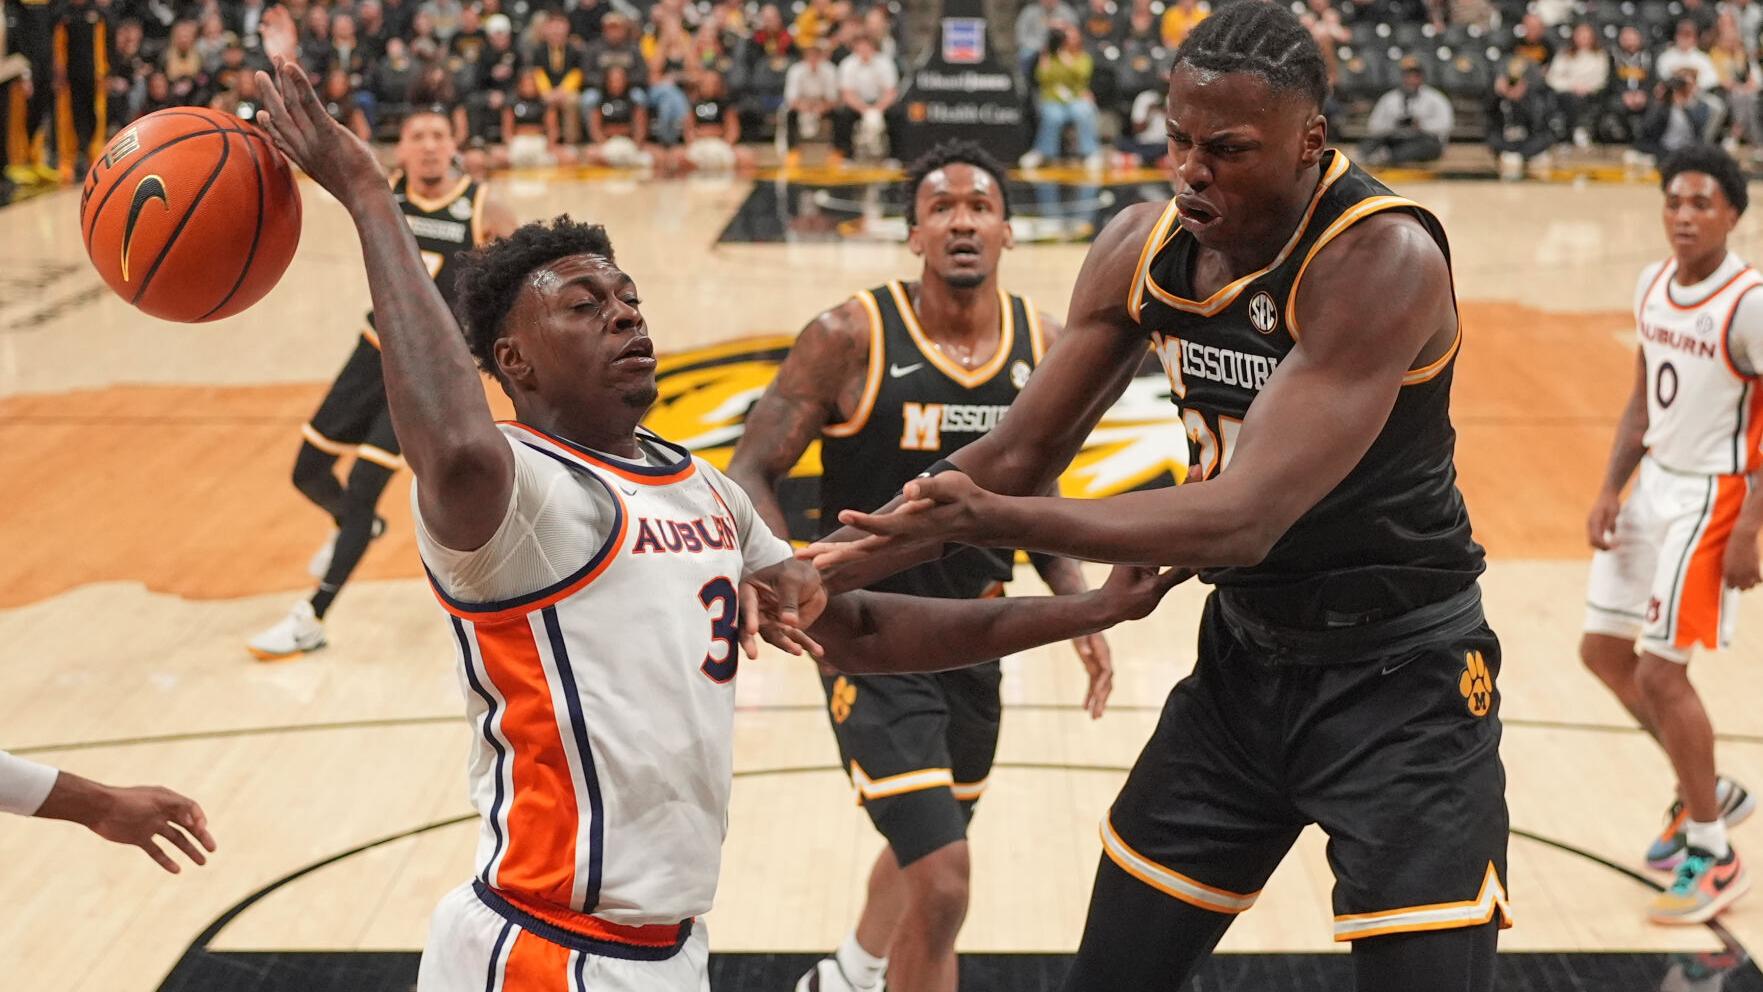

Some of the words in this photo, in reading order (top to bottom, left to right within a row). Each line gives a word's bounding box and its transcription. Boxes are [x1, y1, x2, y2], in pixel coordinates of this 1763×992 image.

[1251, 293, 1275, 331] SEC
[1657, 362, 1678, 409] 0
[900, 401, 1010, 451] MISSOU
[631, 514, 739, 554] AUBUN
[698, 576, 739, 684] 3
[1473, 691, 1487, 712] M
